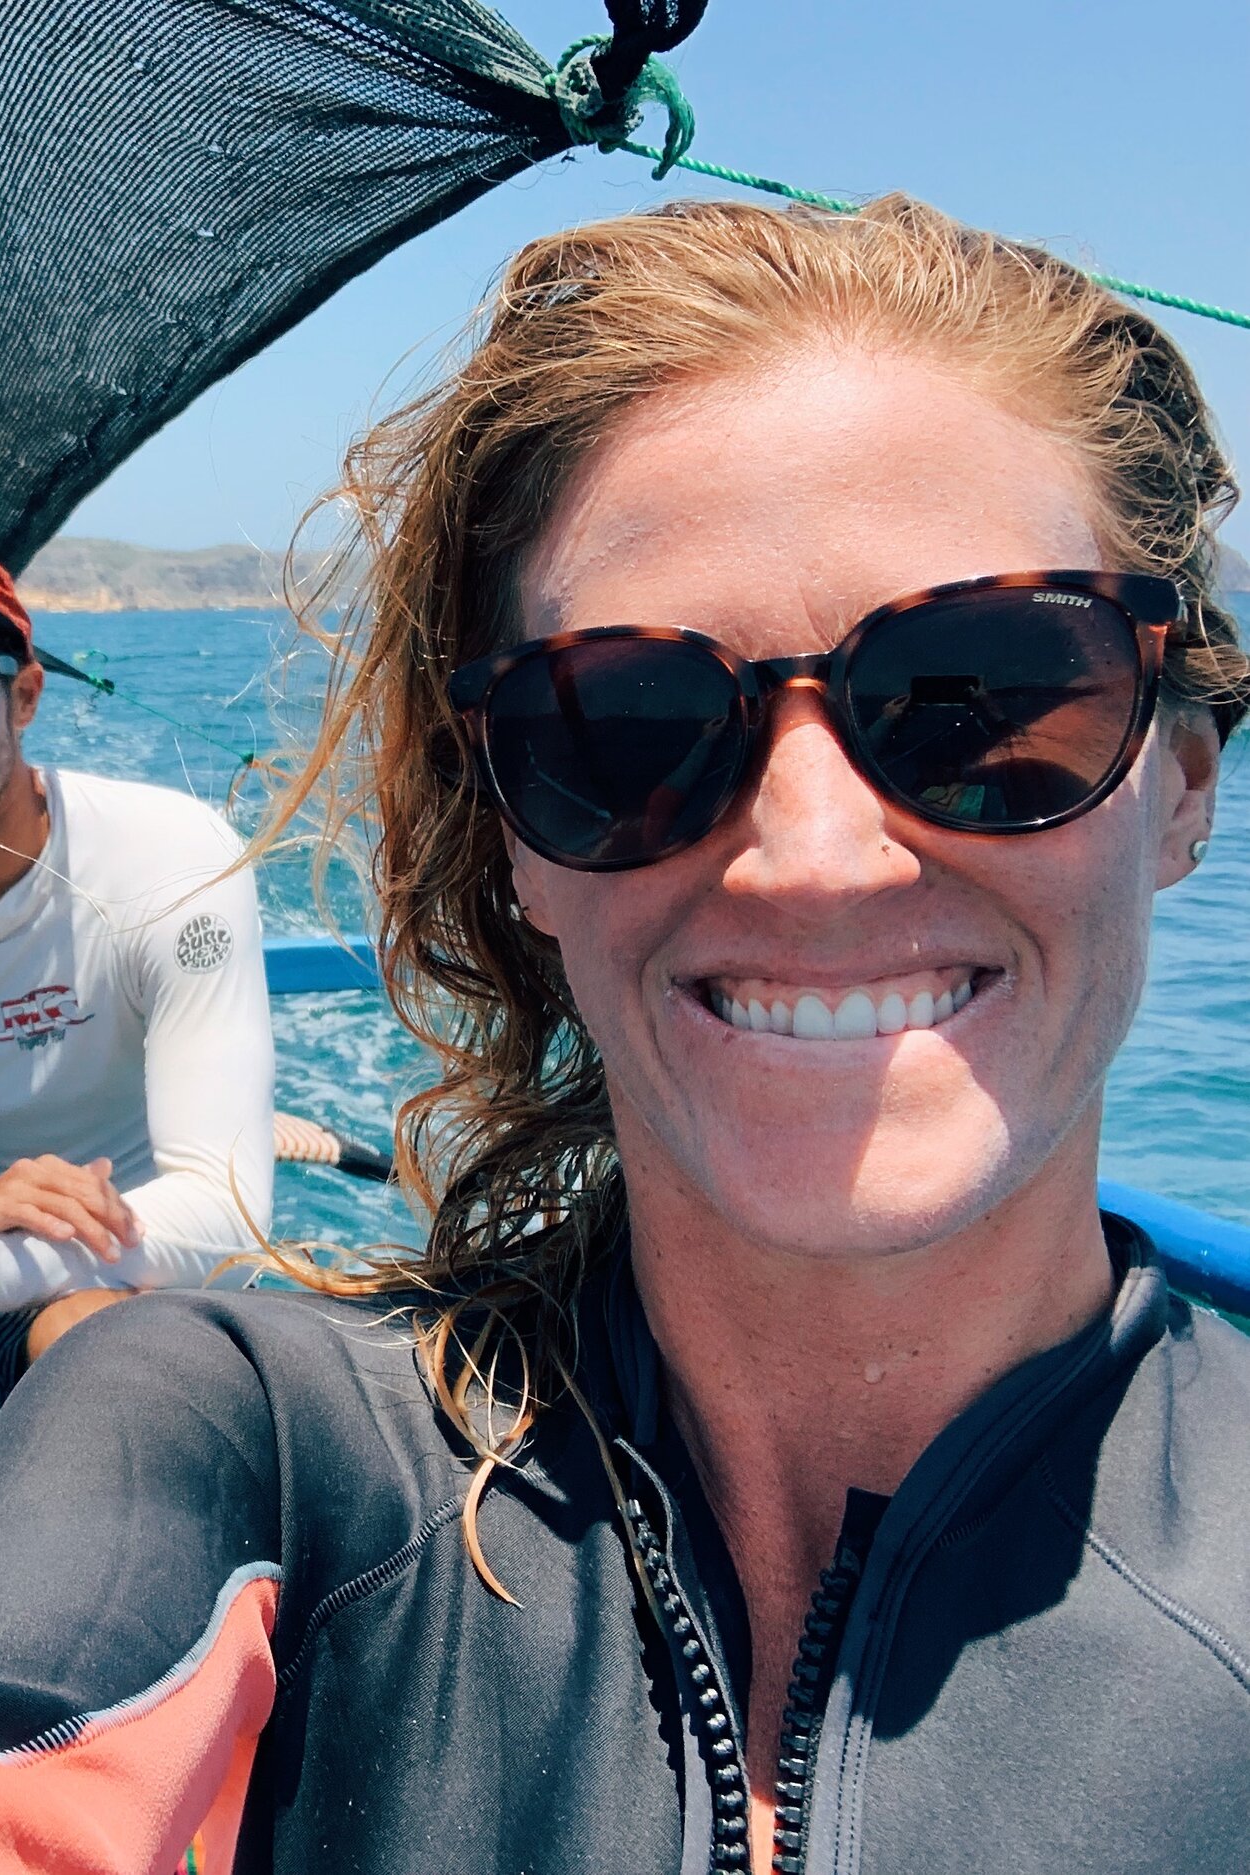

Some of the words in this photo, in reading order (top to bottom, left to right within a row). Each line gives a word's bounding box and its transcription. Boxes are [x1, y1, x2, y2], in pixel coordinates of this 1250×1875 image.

[1032, 592, 1092, 608] SMITH
[177, 916, 212, 945] RIP
[177, 930, 231, 959] CURL
